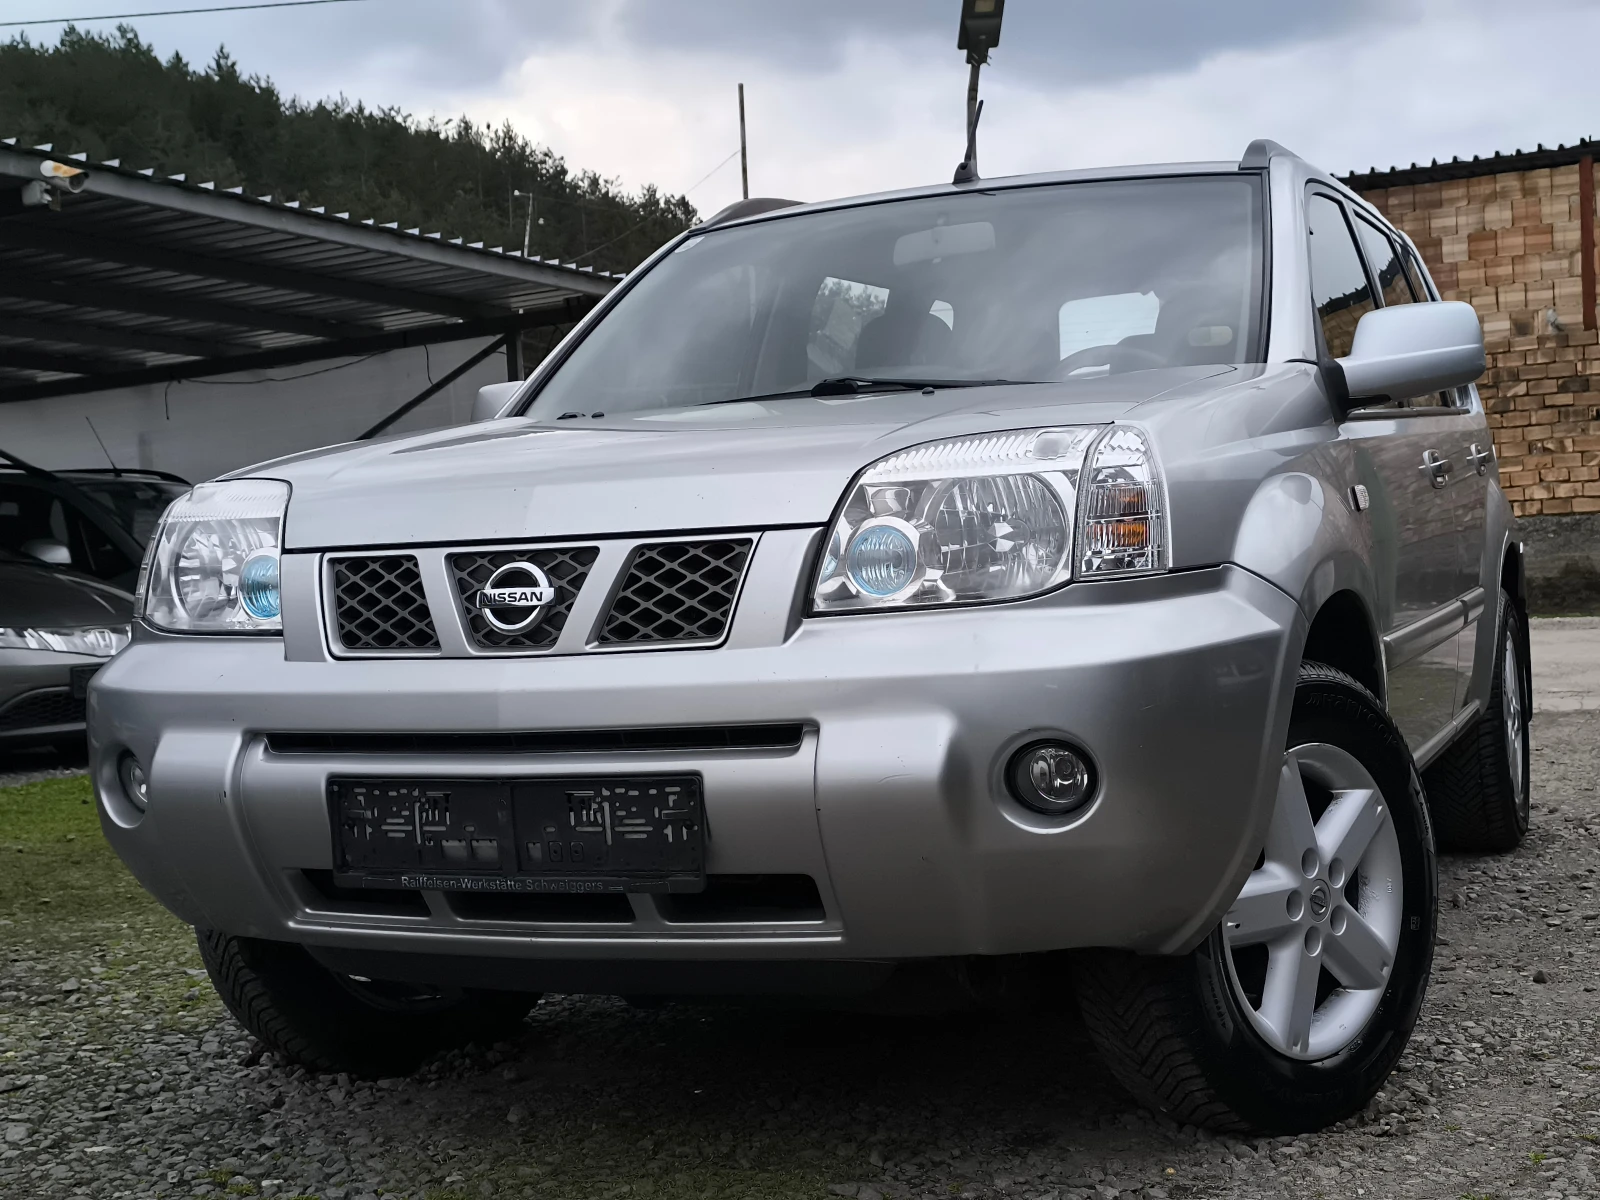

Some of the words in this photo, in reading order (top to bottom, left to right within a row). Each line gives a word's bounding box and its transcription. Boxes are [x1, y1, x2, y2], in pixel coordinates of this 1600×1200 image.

[481, 591, 543, 605] NISSAN
[401, 876, 522, 890] Raiffeisen-Werkstätte
[526, 879, 603, 893] Schweiggers
